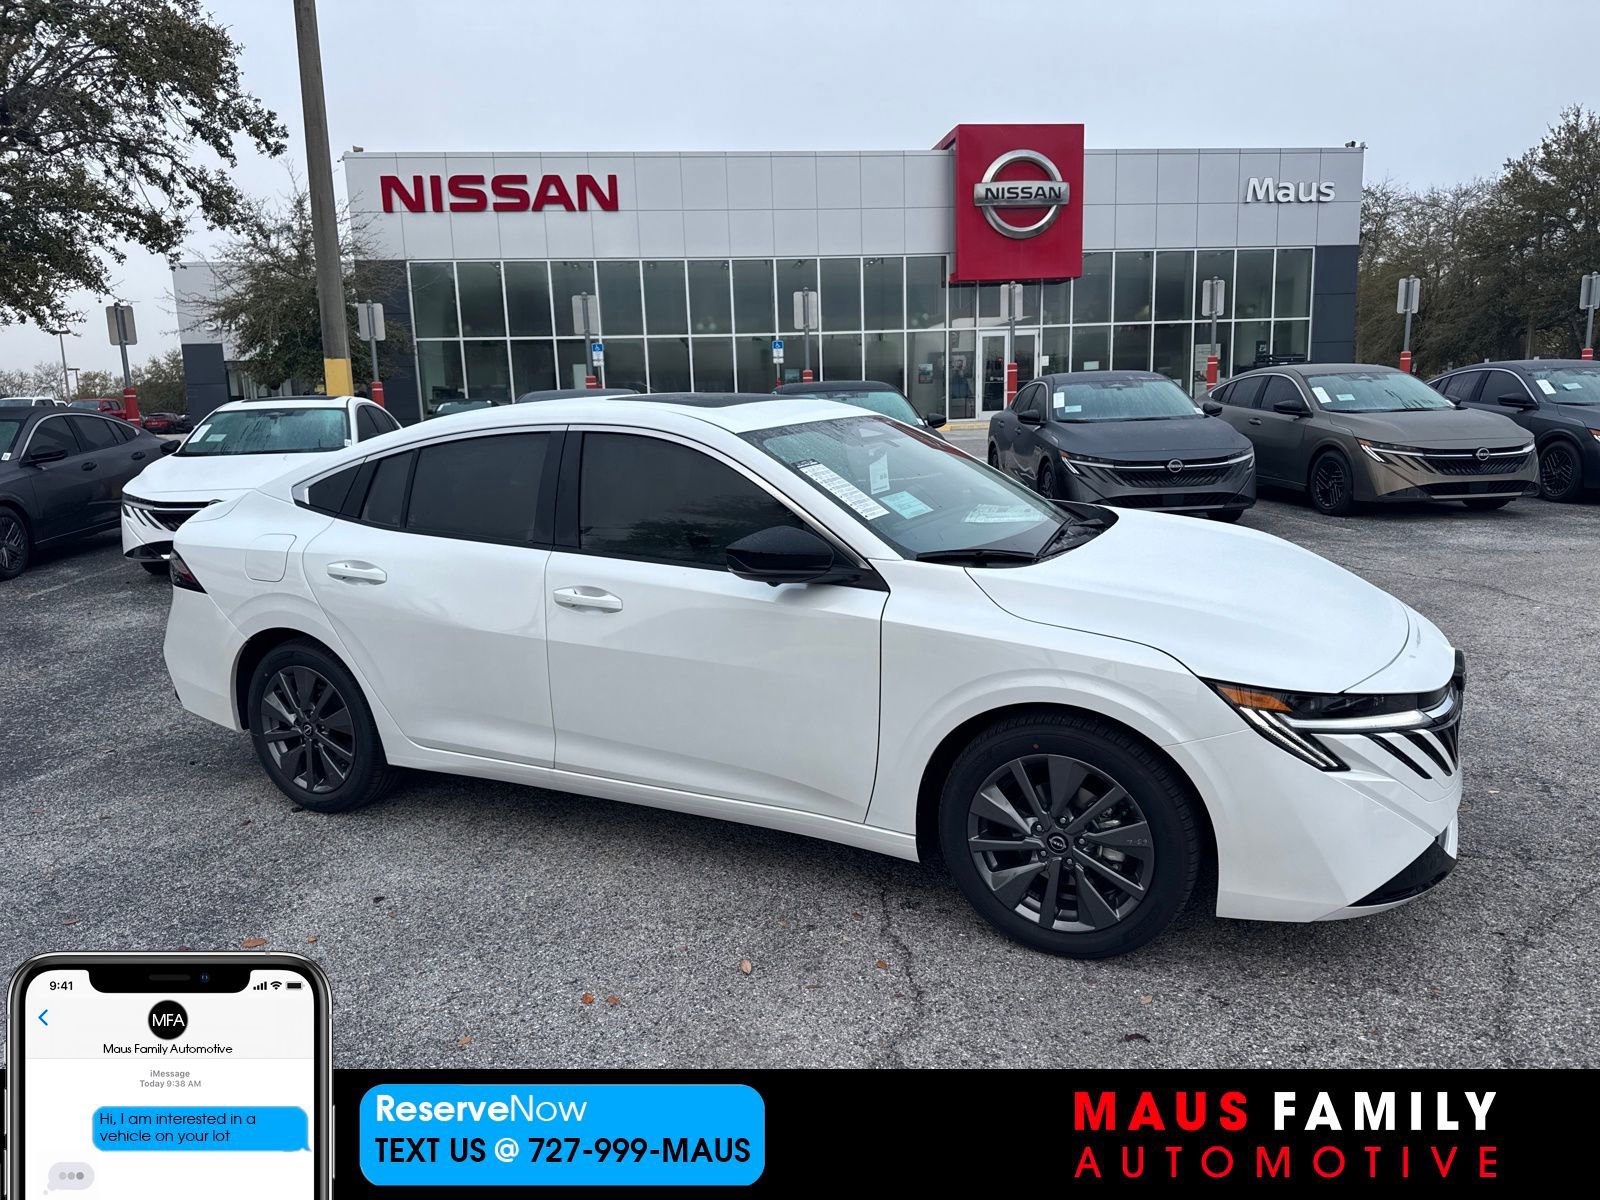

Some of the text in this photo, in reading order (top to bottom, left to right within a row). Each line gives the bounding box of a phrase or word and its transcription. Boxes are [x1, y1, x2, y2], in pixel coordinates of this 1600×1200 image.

[380, 175, 619, 213] NISSAN
[985, 187, 1061, 200] NISSAN
[1246, 177, 1336, 203] Maus
